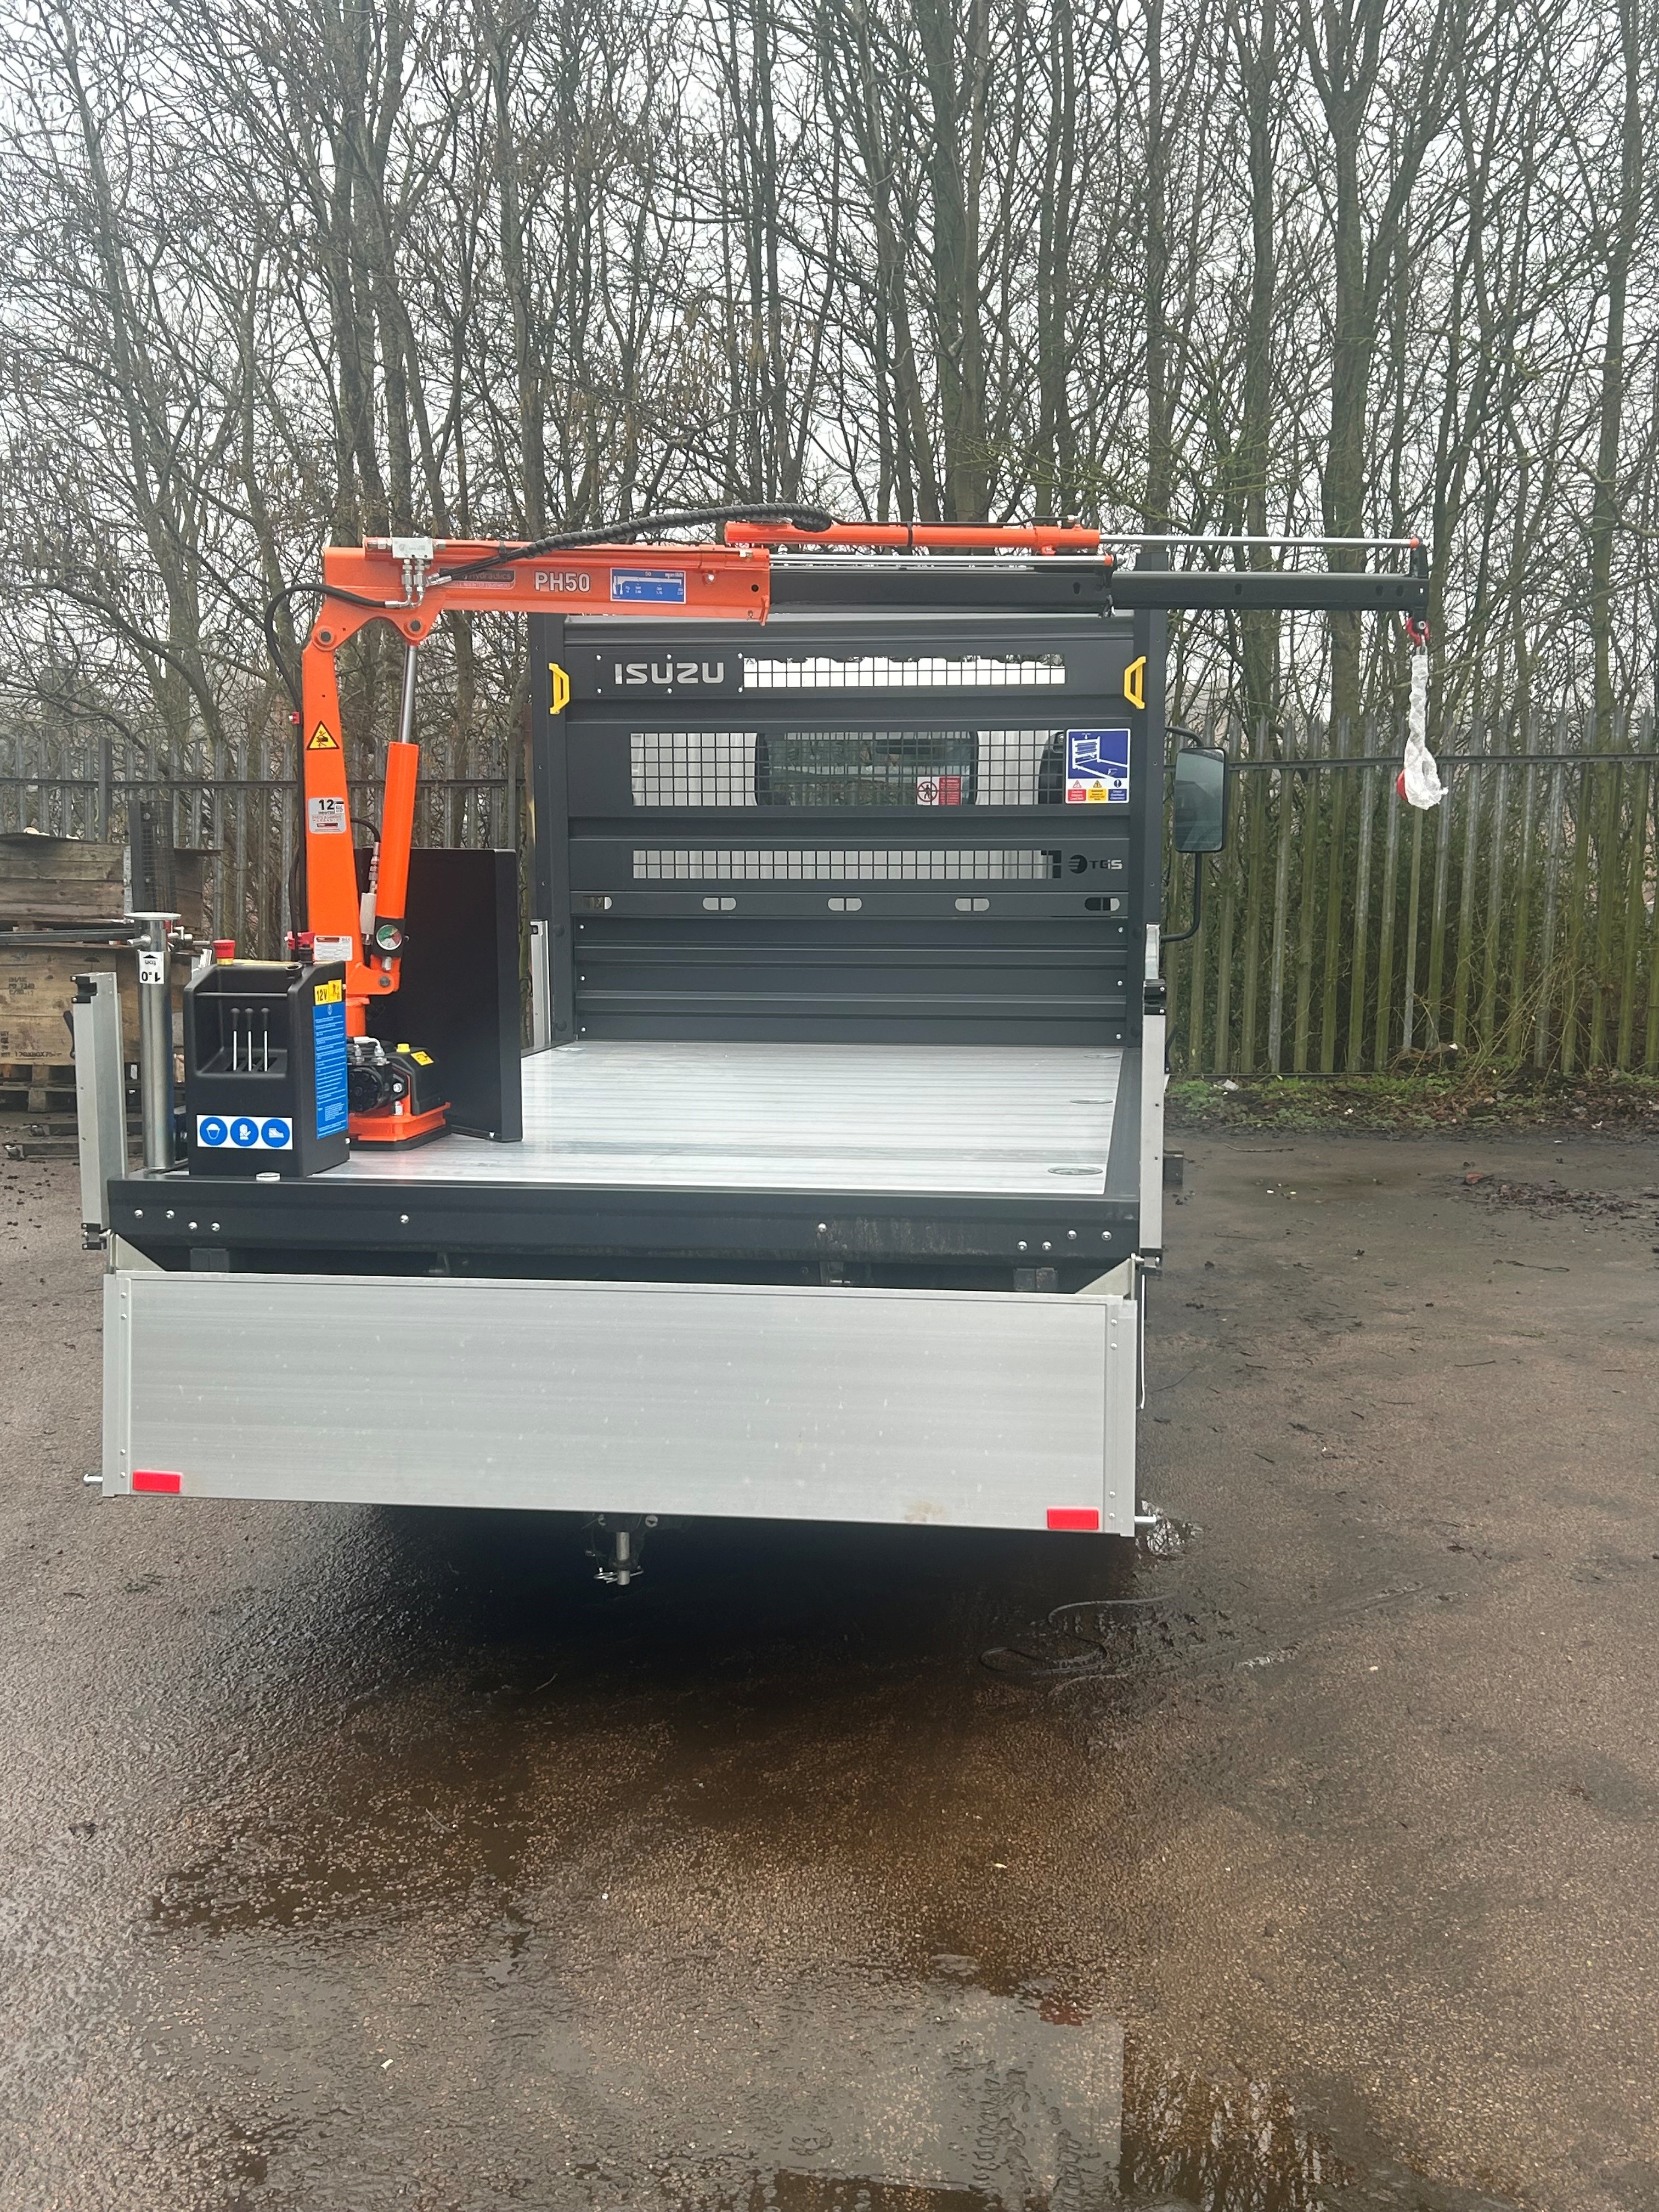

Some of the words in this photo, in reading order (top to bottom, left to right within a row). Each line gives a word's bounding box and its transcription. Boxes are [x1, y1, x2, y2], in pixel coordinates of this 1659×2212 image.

[535, 572, 591, 592] PH50
[614, 662, 724, 684] ISUZU
[319, 799, 335, 810] 12
[142, 971, 161, 982] 1.0
[317, 989, 328, 1001] 12V
